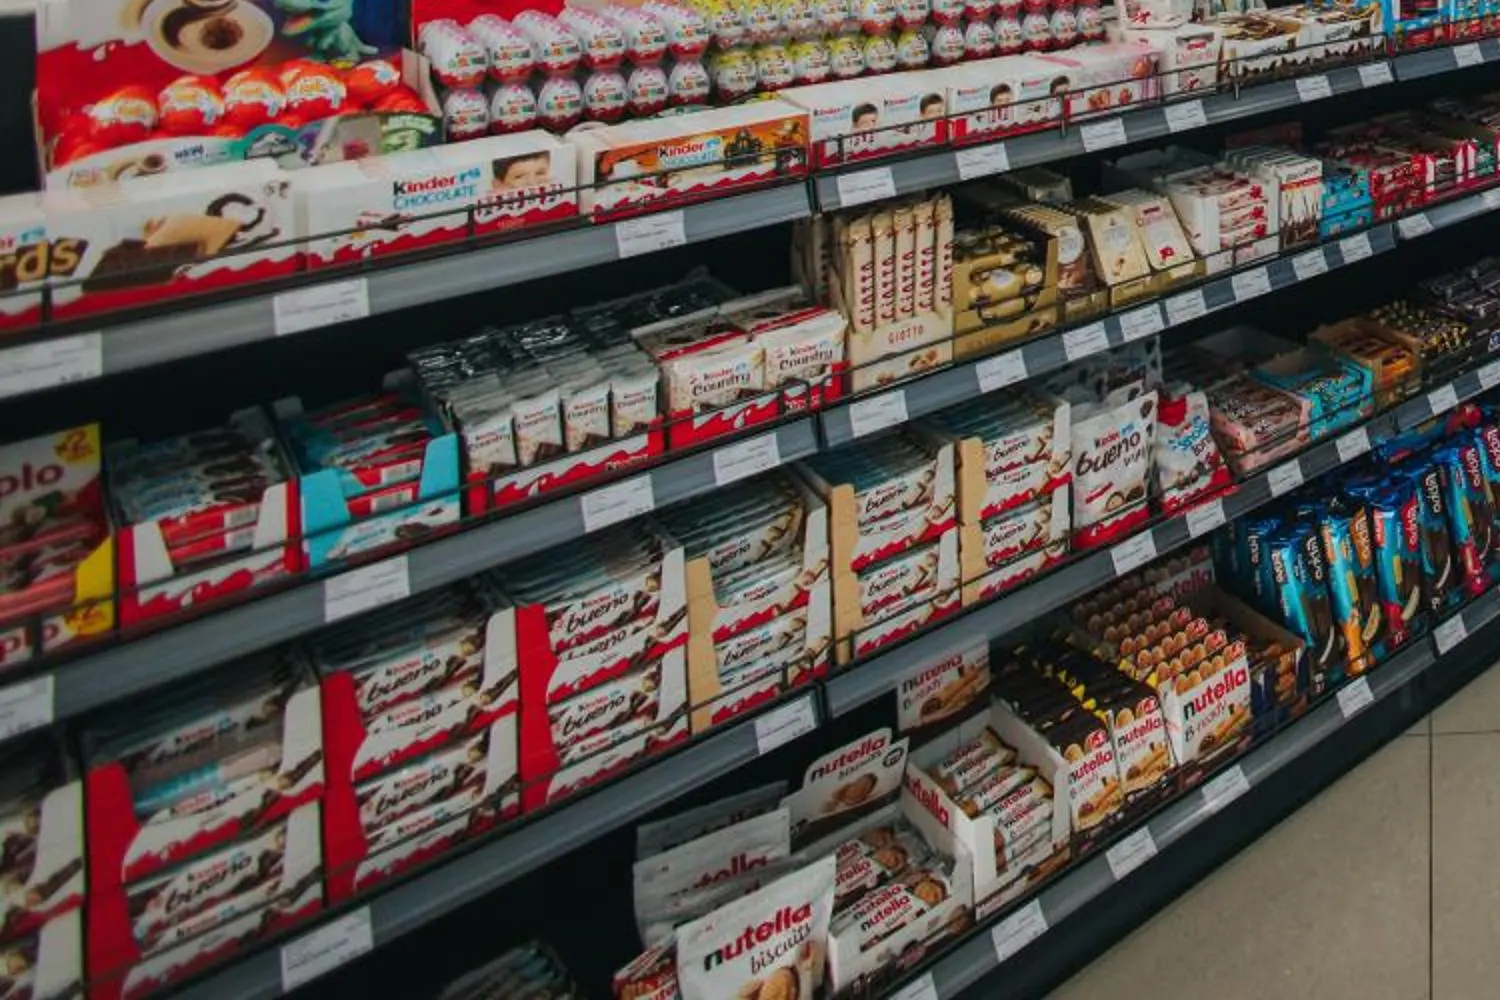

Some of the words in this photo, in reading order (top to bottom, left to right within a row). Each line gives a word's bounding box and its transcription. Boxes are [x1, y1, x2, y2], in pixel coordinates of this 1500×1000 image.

[393, 174, 456, 195] Kinder
[393, 185, 477, 210] CHOCOLATE
[1076, 431, 1141, 476] bueno
[567, 593, 629, 633] bueno
[368, 659, 441, 703] bueno
[1183, 666, 1249, 721] nutella
[562, 695, 626, 736] bueno
[1117, 716, 1164, 747] nutella
[811, 736, 886, 782] nutella
[376, 768, 448, 815] bueno
[166, 855, 252, 913] bueno
[861, 895, 911, 932] nutella
[704, 901, 812, 972] nutella
[751, 923, 812, 975] biscuits
